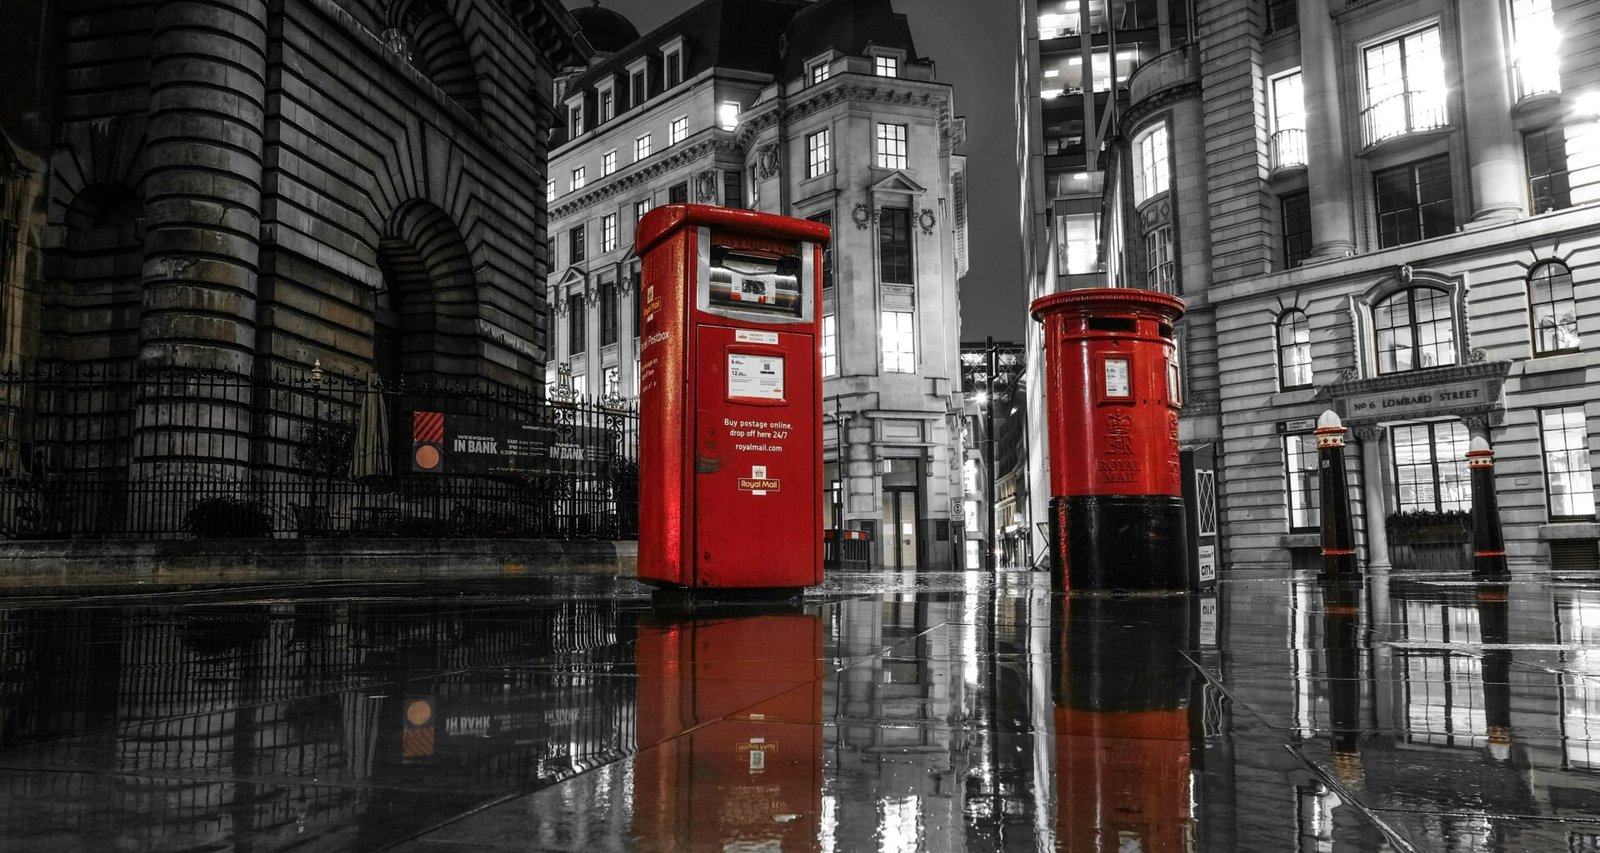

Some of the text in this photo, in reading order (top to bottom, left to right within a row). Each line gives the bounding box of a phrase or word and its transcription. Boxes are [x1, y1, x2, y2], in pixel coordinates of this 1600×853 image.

[1369, 401, 1376, 409] 6
[1382, 395, 1432, 408] LOMBARD
[1439, 389, 1480, 401] STREET
[724, 418, 738, 427] Buy
[740, 420, 768, 429] postage
[457, 434, 495, 442] WEEKDAYS
[729, 429, 745, 438] drop
[757, 430, 772, 438] here
[773, 431, 788, 439] 24/7
[453, 439, 498, 454] IN BANK
[735, 443, 783, 452] royalmail.com
[549, 446, 560, 459] IN
[560, 447, 585, 460] BANK
[1097, 459, 1141, 472] ROYAL
[1103, 471, 1139, 483] MAIL
[741, 480, 778, 489] Royal Mail
